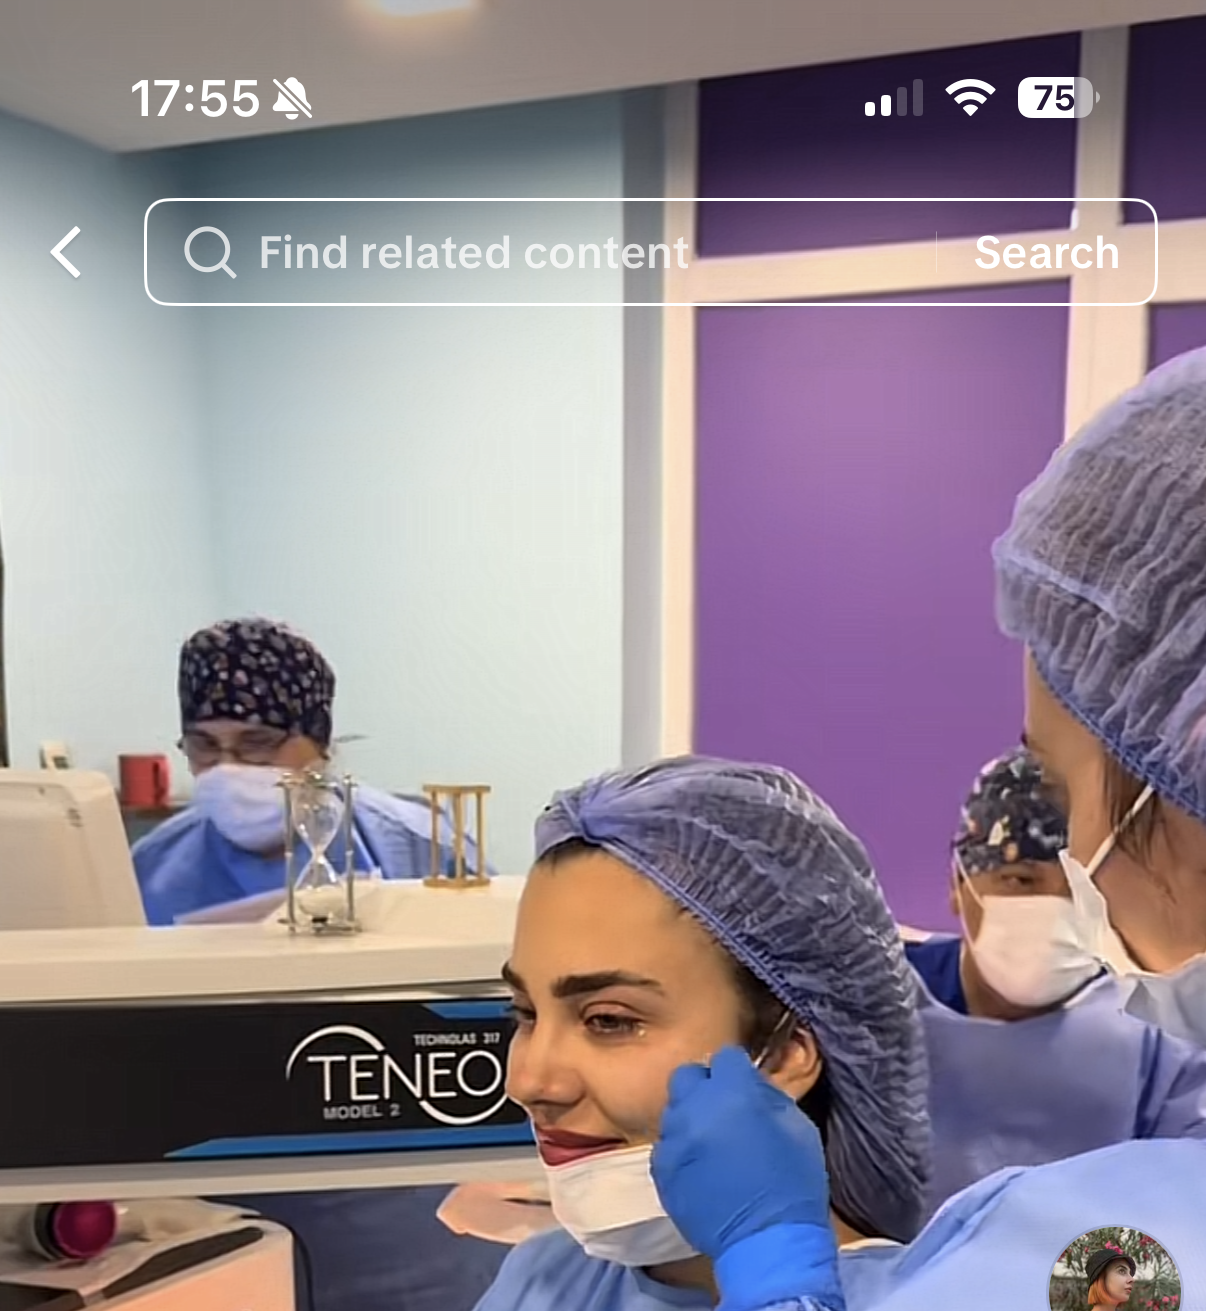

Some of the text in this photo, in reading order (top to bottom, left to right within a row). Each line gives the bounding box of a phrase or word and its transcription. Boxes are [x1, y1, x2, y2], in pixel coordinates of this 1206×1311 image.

[307, 1050, 501, 1101] TENEO
[323, 1102, 402, 1120] MODEL 2
